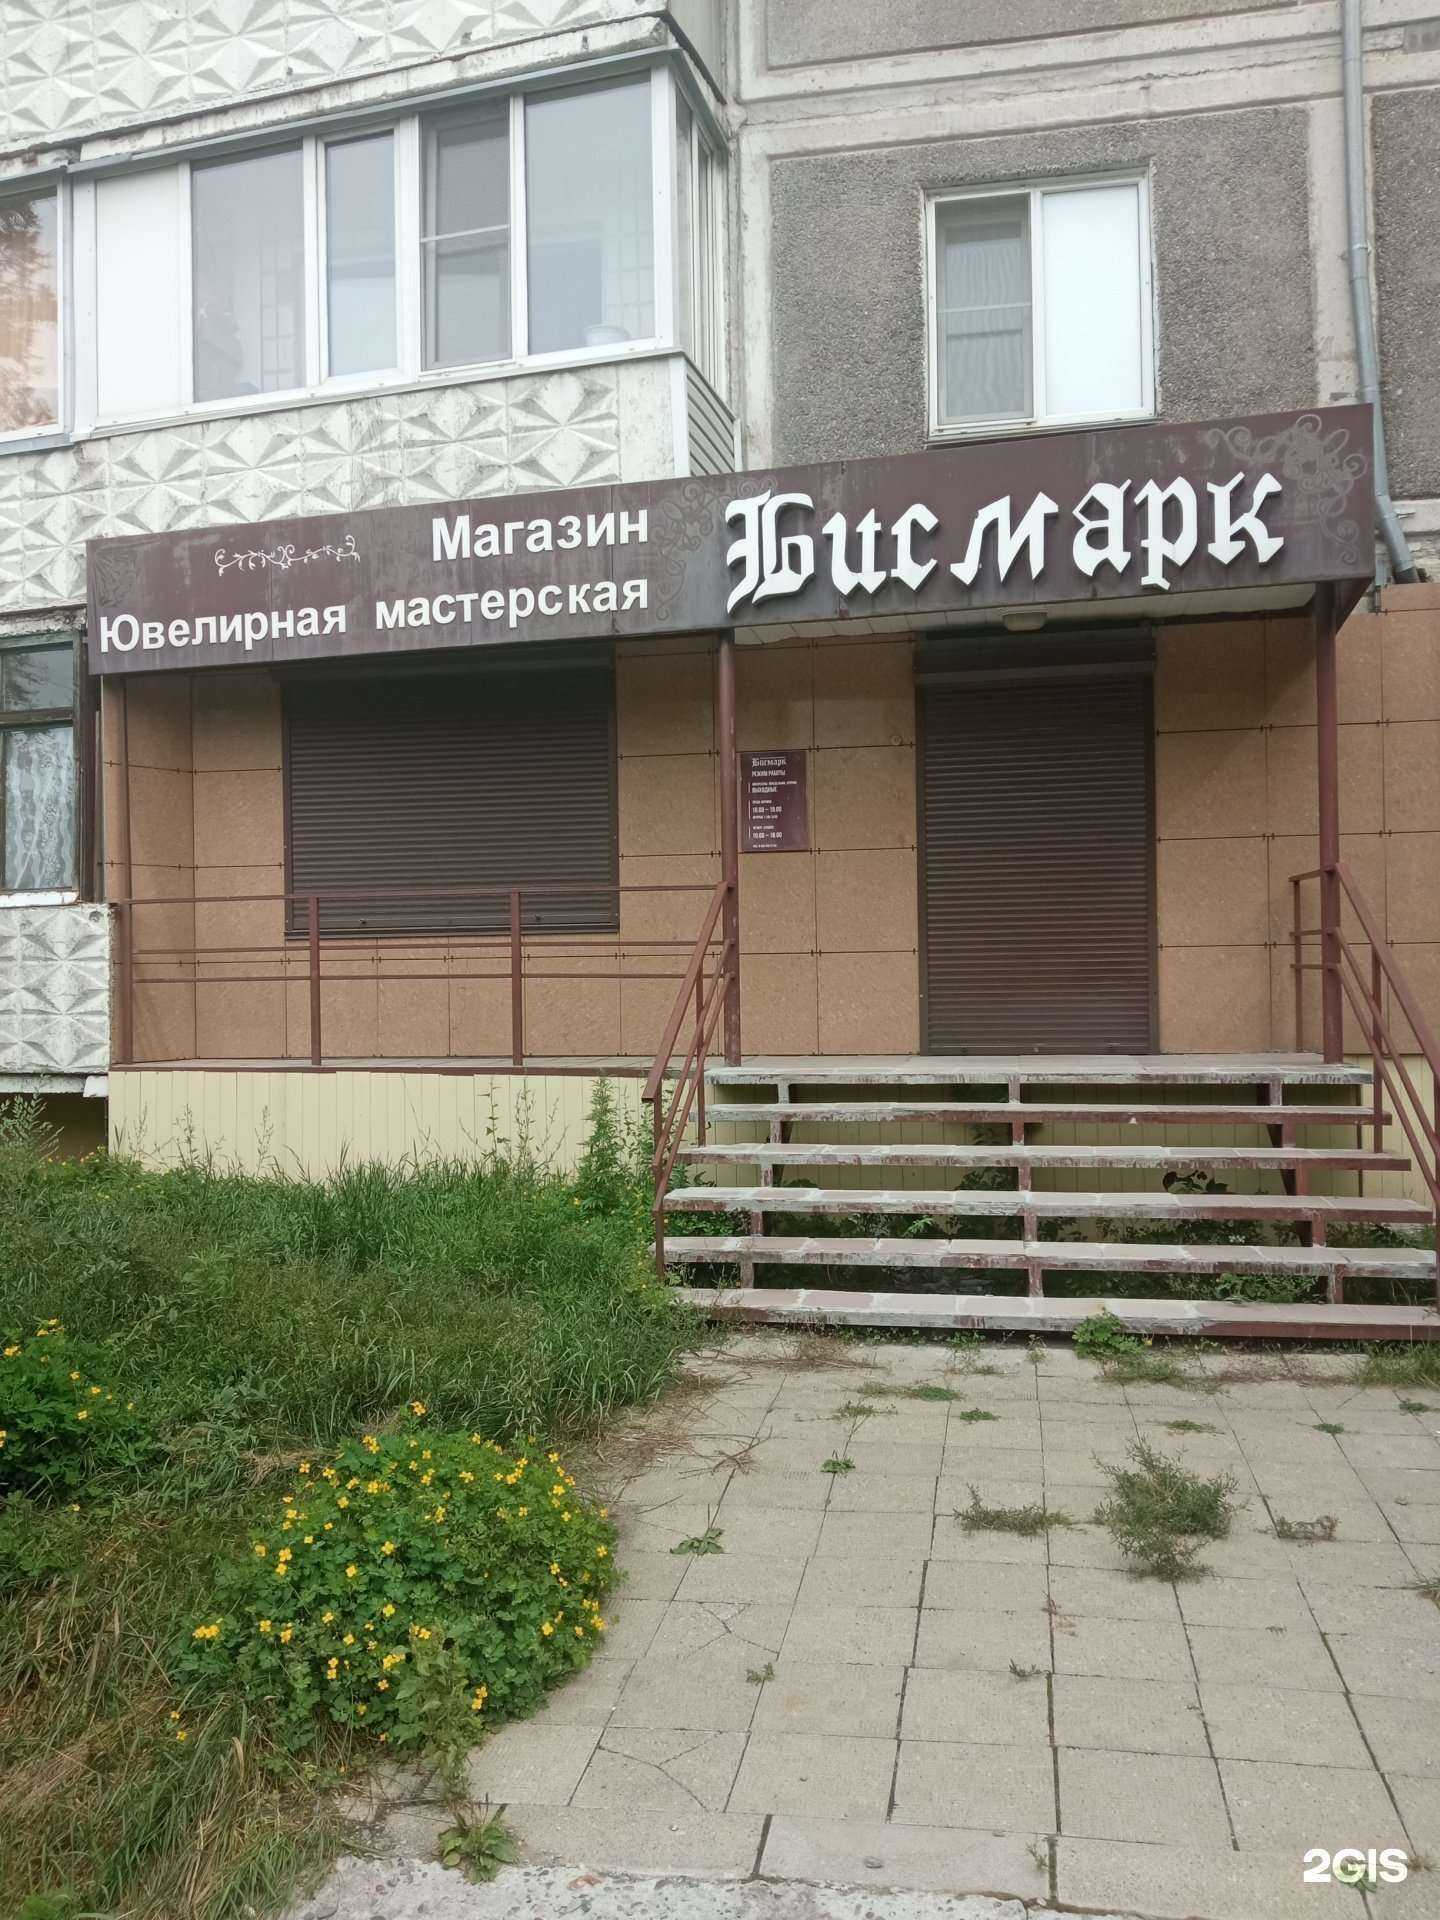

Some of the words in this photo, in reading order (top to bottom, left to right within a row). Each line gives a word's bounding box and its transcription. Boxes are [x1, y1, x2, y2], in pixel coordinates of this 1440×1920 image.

[432, 510, 647, 561] Магазин
[100, 605, 346, 652] Ювелирная
[376, 579, 647, 629] мастерская
